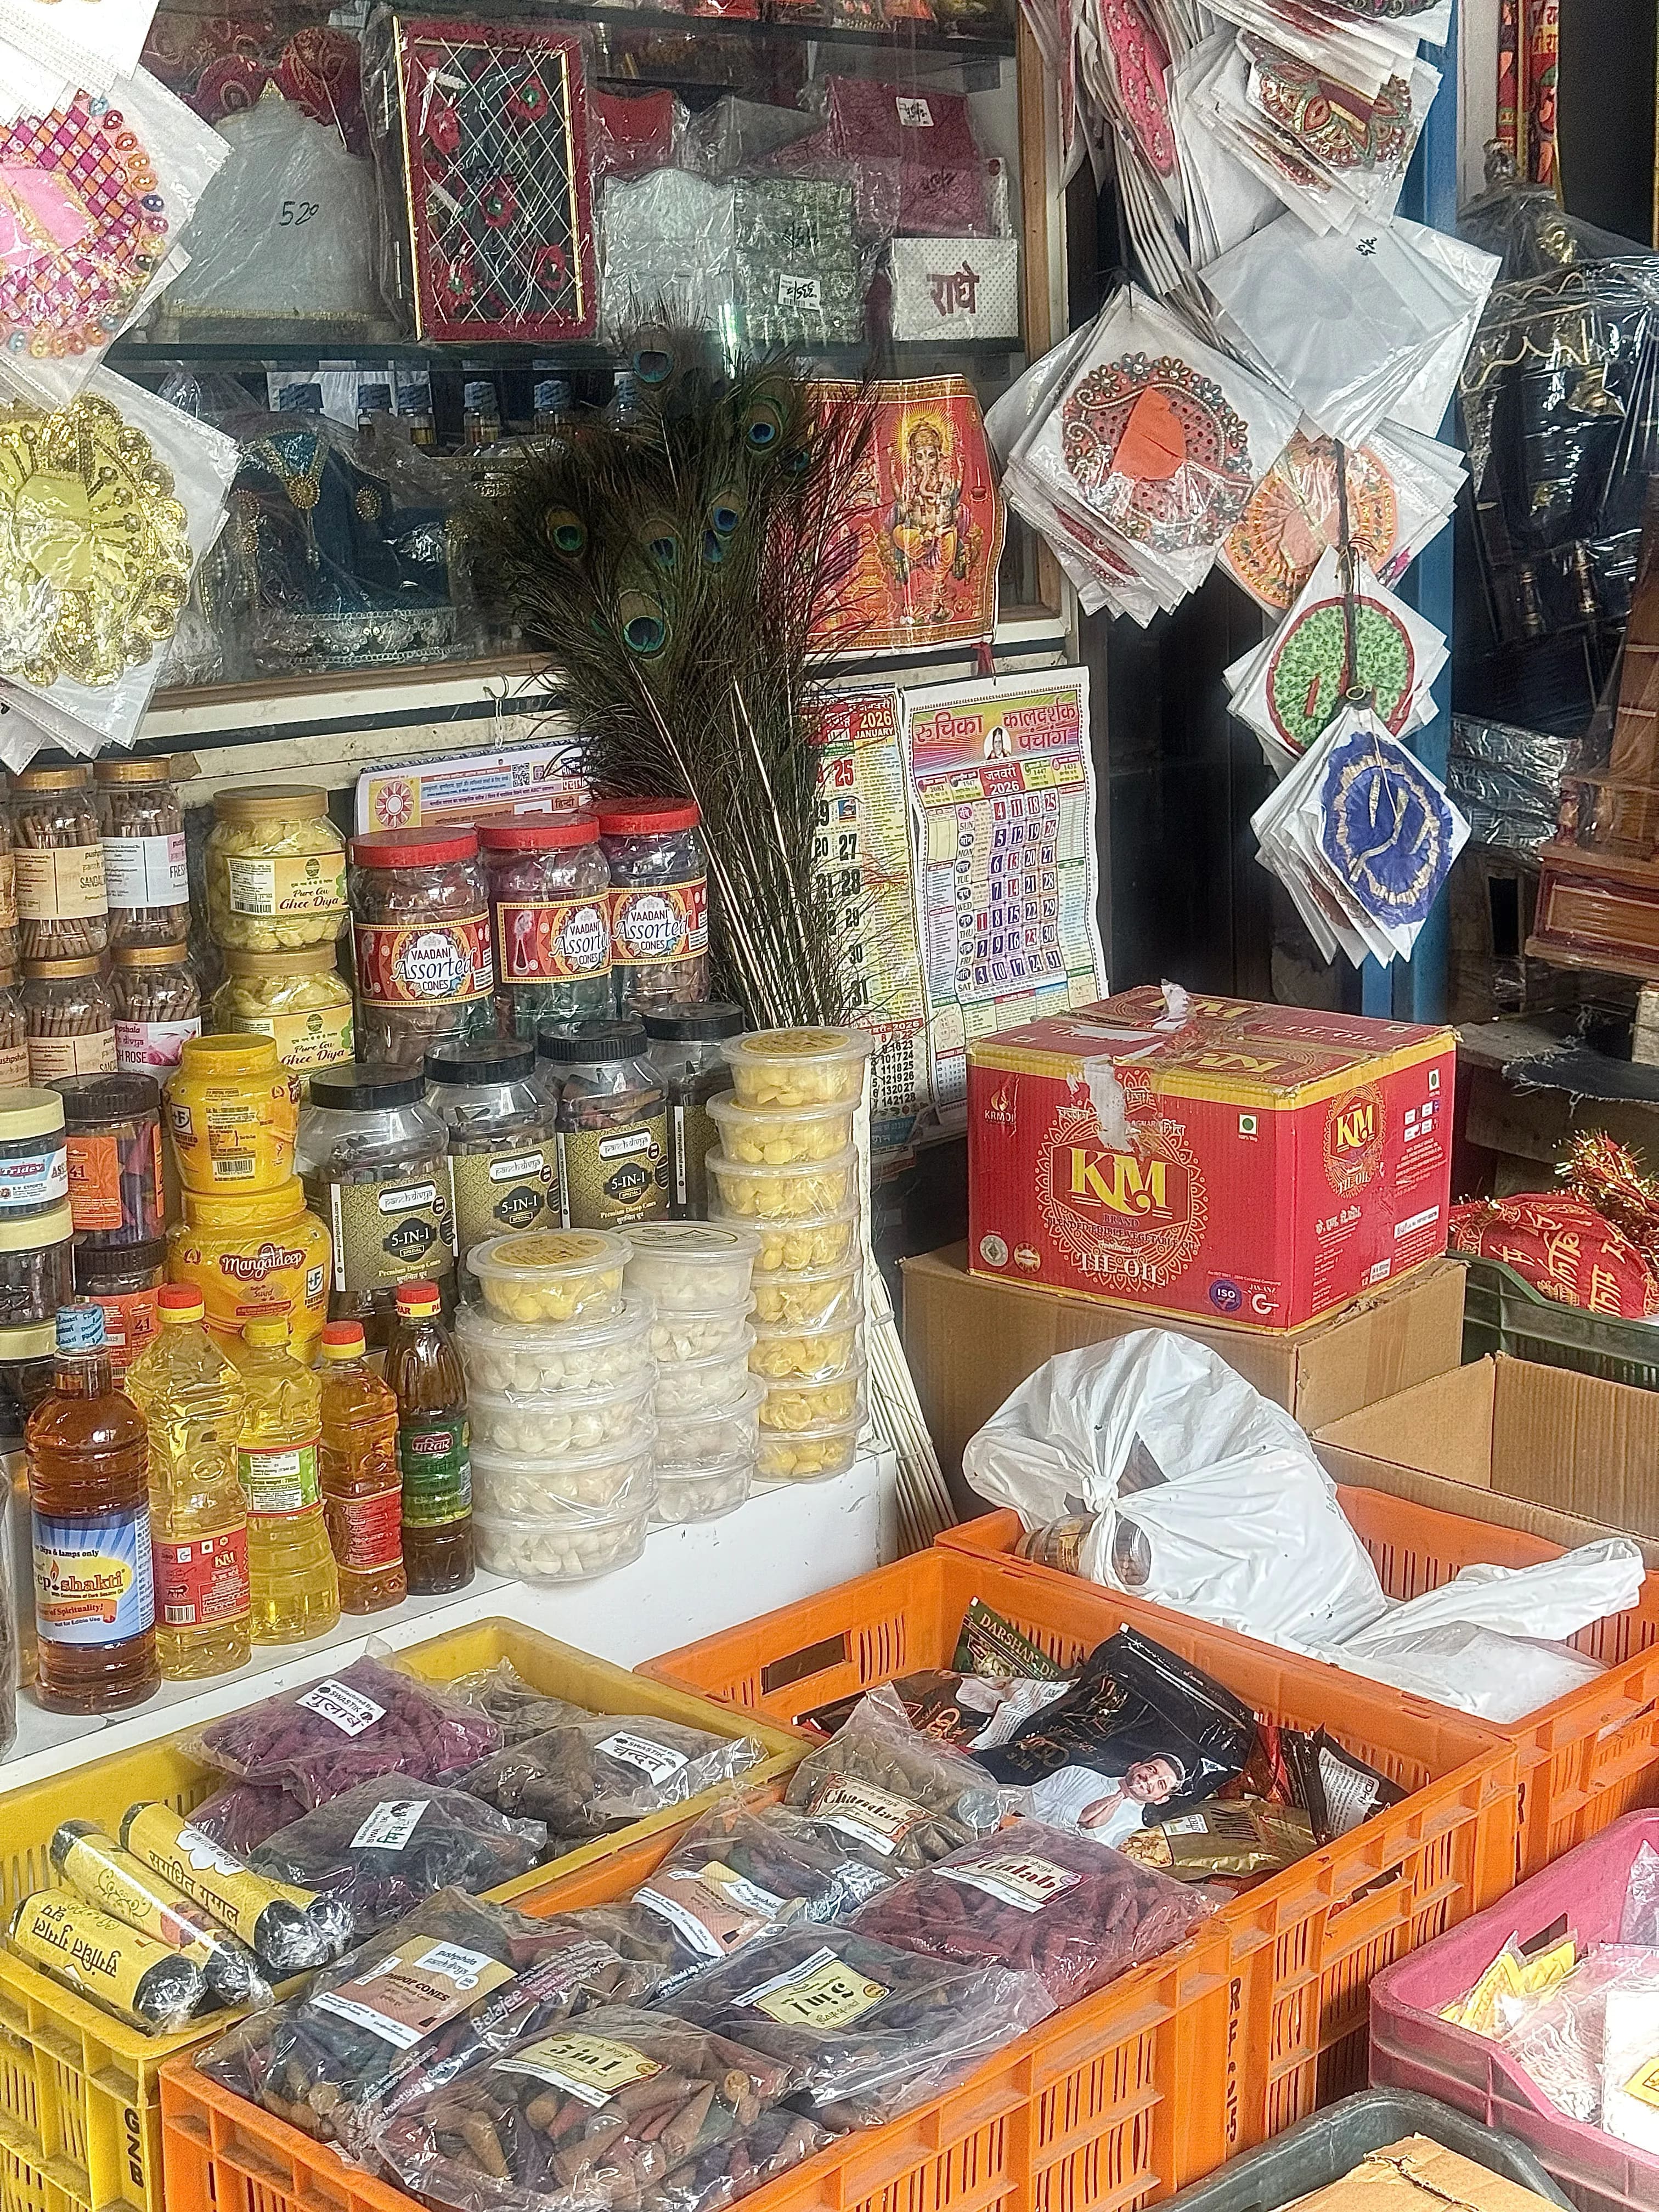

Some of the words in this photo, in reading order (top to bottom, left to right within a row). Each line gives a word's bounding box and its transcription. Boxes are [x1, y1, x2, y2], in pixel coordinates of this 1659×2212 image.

[279, 201, 319, 226] 520
[927, 262, 980, 316] राधे
[860, 711, 892, 729] 2026
[915, 711, 984, 742] रुचिका
[1001, 698, 1077, 729] कालदर्शक
[854, 727, 895, 740] JANUARY
[1018, 724, 1069, 751] पंचांग
[834, 759, 854, 787] 25
[985, 765, 1017, 781] जनवरी
[990, 780, 1020, 796] 2026
[555, 795, 575, 809] हिन्दी
[996, 804, 1005, 820] 4
[1012, 800, 1022, 817] 11
[1028, 797, 1039, 814] 18
[1046, 794, 1056, 810] 25
[996, 830, 1004, 847] 5
[1013, 827, 1023, 844] 12
[1030, 824, 1040, 840] 19
[1045, 822, 1055, 837] 26
[839, 833, 857, 861] 27
[994, 857, 1000, 873] 6
[1008, 853, 1019, 870] 13
[1025, 850, 1035, 866] 20
[1042, 847, 1052, 864] 27
[841, 868, 861, 896] 28
[994, 883, 999, 899] 7
[1008, 879, 1019, 896] 14
[1025, 877, 1035, 893] 21
[1044, 873, 1054, 890] 28
[292, 889, 314, 898] Pure
[279, 898, 309, 910] Ghee
[313, 896, 339, 910] Diya
[630, 910, 669, 922] VAADANI
[845, 908, 860, 928] 29
[980, 913, 985, 930] 1
[995, 910, 1001, 927] 8
[1009, 907, 1019, 924] 15
[1026, 904, 1037, 920] 22
[1044, 899, 1055, 916] 29
[611, 910, 692, 940] Assorted
[640, 940, 665, 951] CONES
[979, 941, 985, 957] 2
[995, 936, 1001, 953] 9
[1009, 933, 1019, 950] 16
[1026, 929, 1036, 946] 23
[1043, 926, 1054, 942] 30
[410, 947, 452, 961] VAADANI
[579, 953, 599, 965] CONES
[390, 947, 478, 981] Assorted
[979, 967, 985, 984] 3
[994, 963, 1006, 980] 10
[1012, 960, 1024, 976] 17
[1030, 956, 1042, 972] 24
[1048, 952, 1060, 968] 31
[422, 979, 449, 991] CONES
[881, 1034, 887, 1043] 8
[902, 1040, 913, 1050] 23
[126, 1051, 148, 1064] ROSE
[280, 1054, 313, 1065] Ghee
[317, 1049, 345, 1062] Diya
[294, 1045, 317, 1053] Pure
[881, 1053, 891, 1064] 10
[892, 1052, 902, 1062] 17
[902, 1049, 914, 1060] 24
[881, 1064, 891, 1075] 11
[892, 1063, 902, 1073] 18
[903, 1060, 914, 1070] 25
[872, 1078, 878, 1088] 5
[882, 1075, 891, 1086] 12
[892, 1073, 902, 1084] 19
[904, 1071, 915, 1081] 26
[881, 1086, 891, 1097] 13
[892, 1085, 903, 1094] 20
[904, 1081, 915, 1093] 27
[882, 1097, 893, 1108] 14
[894, 1096, 904, 1105] 21
[904, 1092, 916, 1103] 28
[1336, 1104, 1374, 1148] KM
[1, 1163, 44, 1177] Tridev
[611, 1171, 645, 1190] 5-IN-1
[1068, 1146, 1172, 1216] KM
[501, 1195, 538, 1214] 5-IN-1
[600, 1209, 625, 1218] Premium
[1103, 1213, 1140, 1228] BRAND
[391, 1227, 430, 1246] 5-IN-1
[1047, 1216, 1090, 1231] BLENDED
[1091, 1223, 1125, 1236] EDIBLE
[1126, 1227, 1180, 1248] VEGETABLE
[1181, 1240, 1199, 1251] OIL
[402, 1246, 423, 1256] SPECIAL
[221, 1246, 302, 1278] Mangaldeep
[378, 1267, 407, 1278] Premium
[407, 1263, 426, 1273] Dhoop
[1079, 1252, 1118, 1274] TIL
[1124, 1259, 1166, 1286] OIL
[1217, 1288, 1236, 1299] ISO
[414, 1437, 451, 1452] परिवार
[59, 1550, 81, 1559] lamps
[60, 1571, 124, 1592] shakti
[58, 1603, 104, 1616] Spirituality!
[329, 1691, 362, 1713] SWASTIK
[627, 1741, 665, 1758] SWASTIK
[823, 1788, 906, 1824] Chandan
[977, 1861, 1056, 1889] Gulab
[385, 1972, 416, 1985] DHOOP
[414, 1982, 452, 2002] CONES
[831, 1982, 855, 1999] 5
[810, 1991, 839, 2007] in
[470, 1990, 523, 2031] Balajee
[549, 2044, 577, 2055] 5
[569, 2049, 601, 2066] in
[600, 2061, 623, 2073] 1
